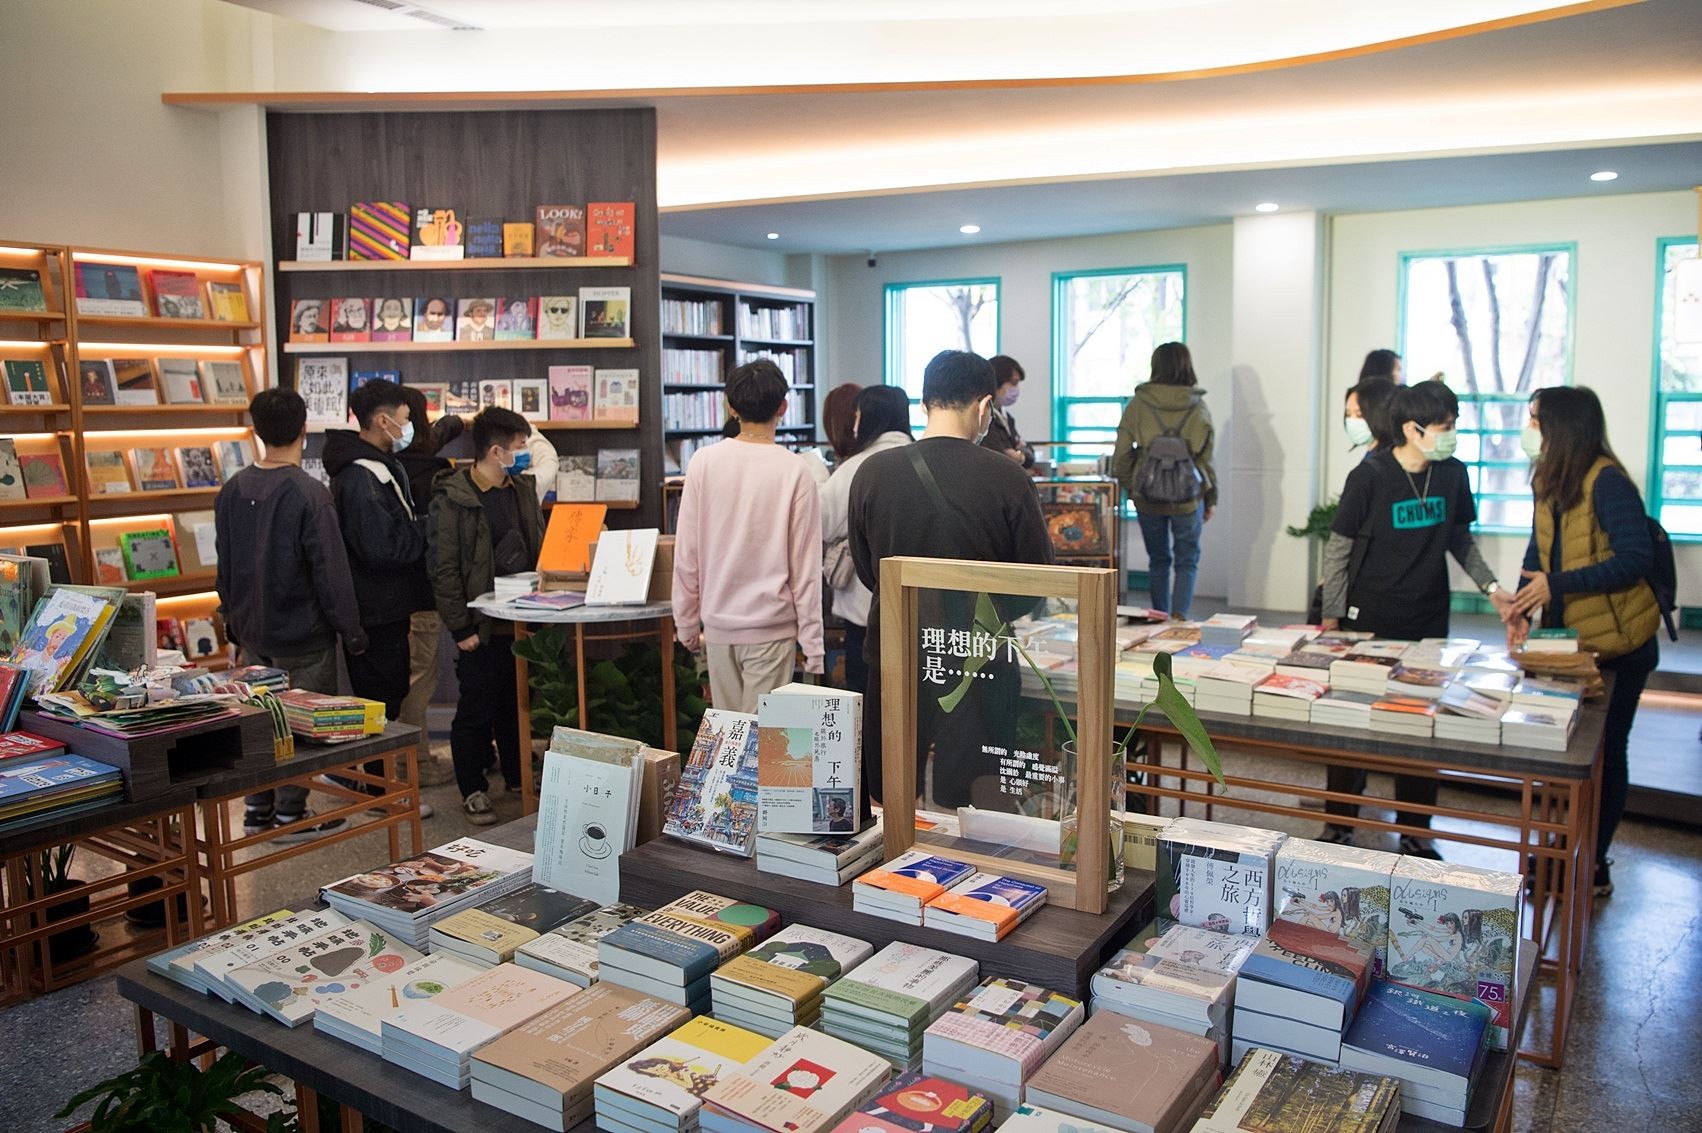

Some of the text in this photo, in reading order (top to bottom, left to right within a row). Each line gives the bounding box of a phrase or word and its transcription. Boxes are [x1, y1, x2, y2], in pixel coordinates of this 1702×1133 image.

[540, 208, 584, 220] LOOK!
[1397, 500, 1444, 524] CHUMS
[921, 627, 1049, 667] 理想的下午
[719, 719, 747, 768] 嘉義
[821, 698, 842, 788] 理想的下午
[583, 784, 612, 798] 小日子
[688, 892, 710, 902] THE
[1220, 865, 1240, 904] 之旅
[674, 899, 721, 916] VALUE
[267, 917, 328, 947] 地味手帖
[643, 913, 732, 945] EVERYTHING
[298, 928, 360, 958] 地味手帖
[1056, 1060, 1117, 1081] Maintenance
[1061, 1054, 1113, 1074] Motorcycle
